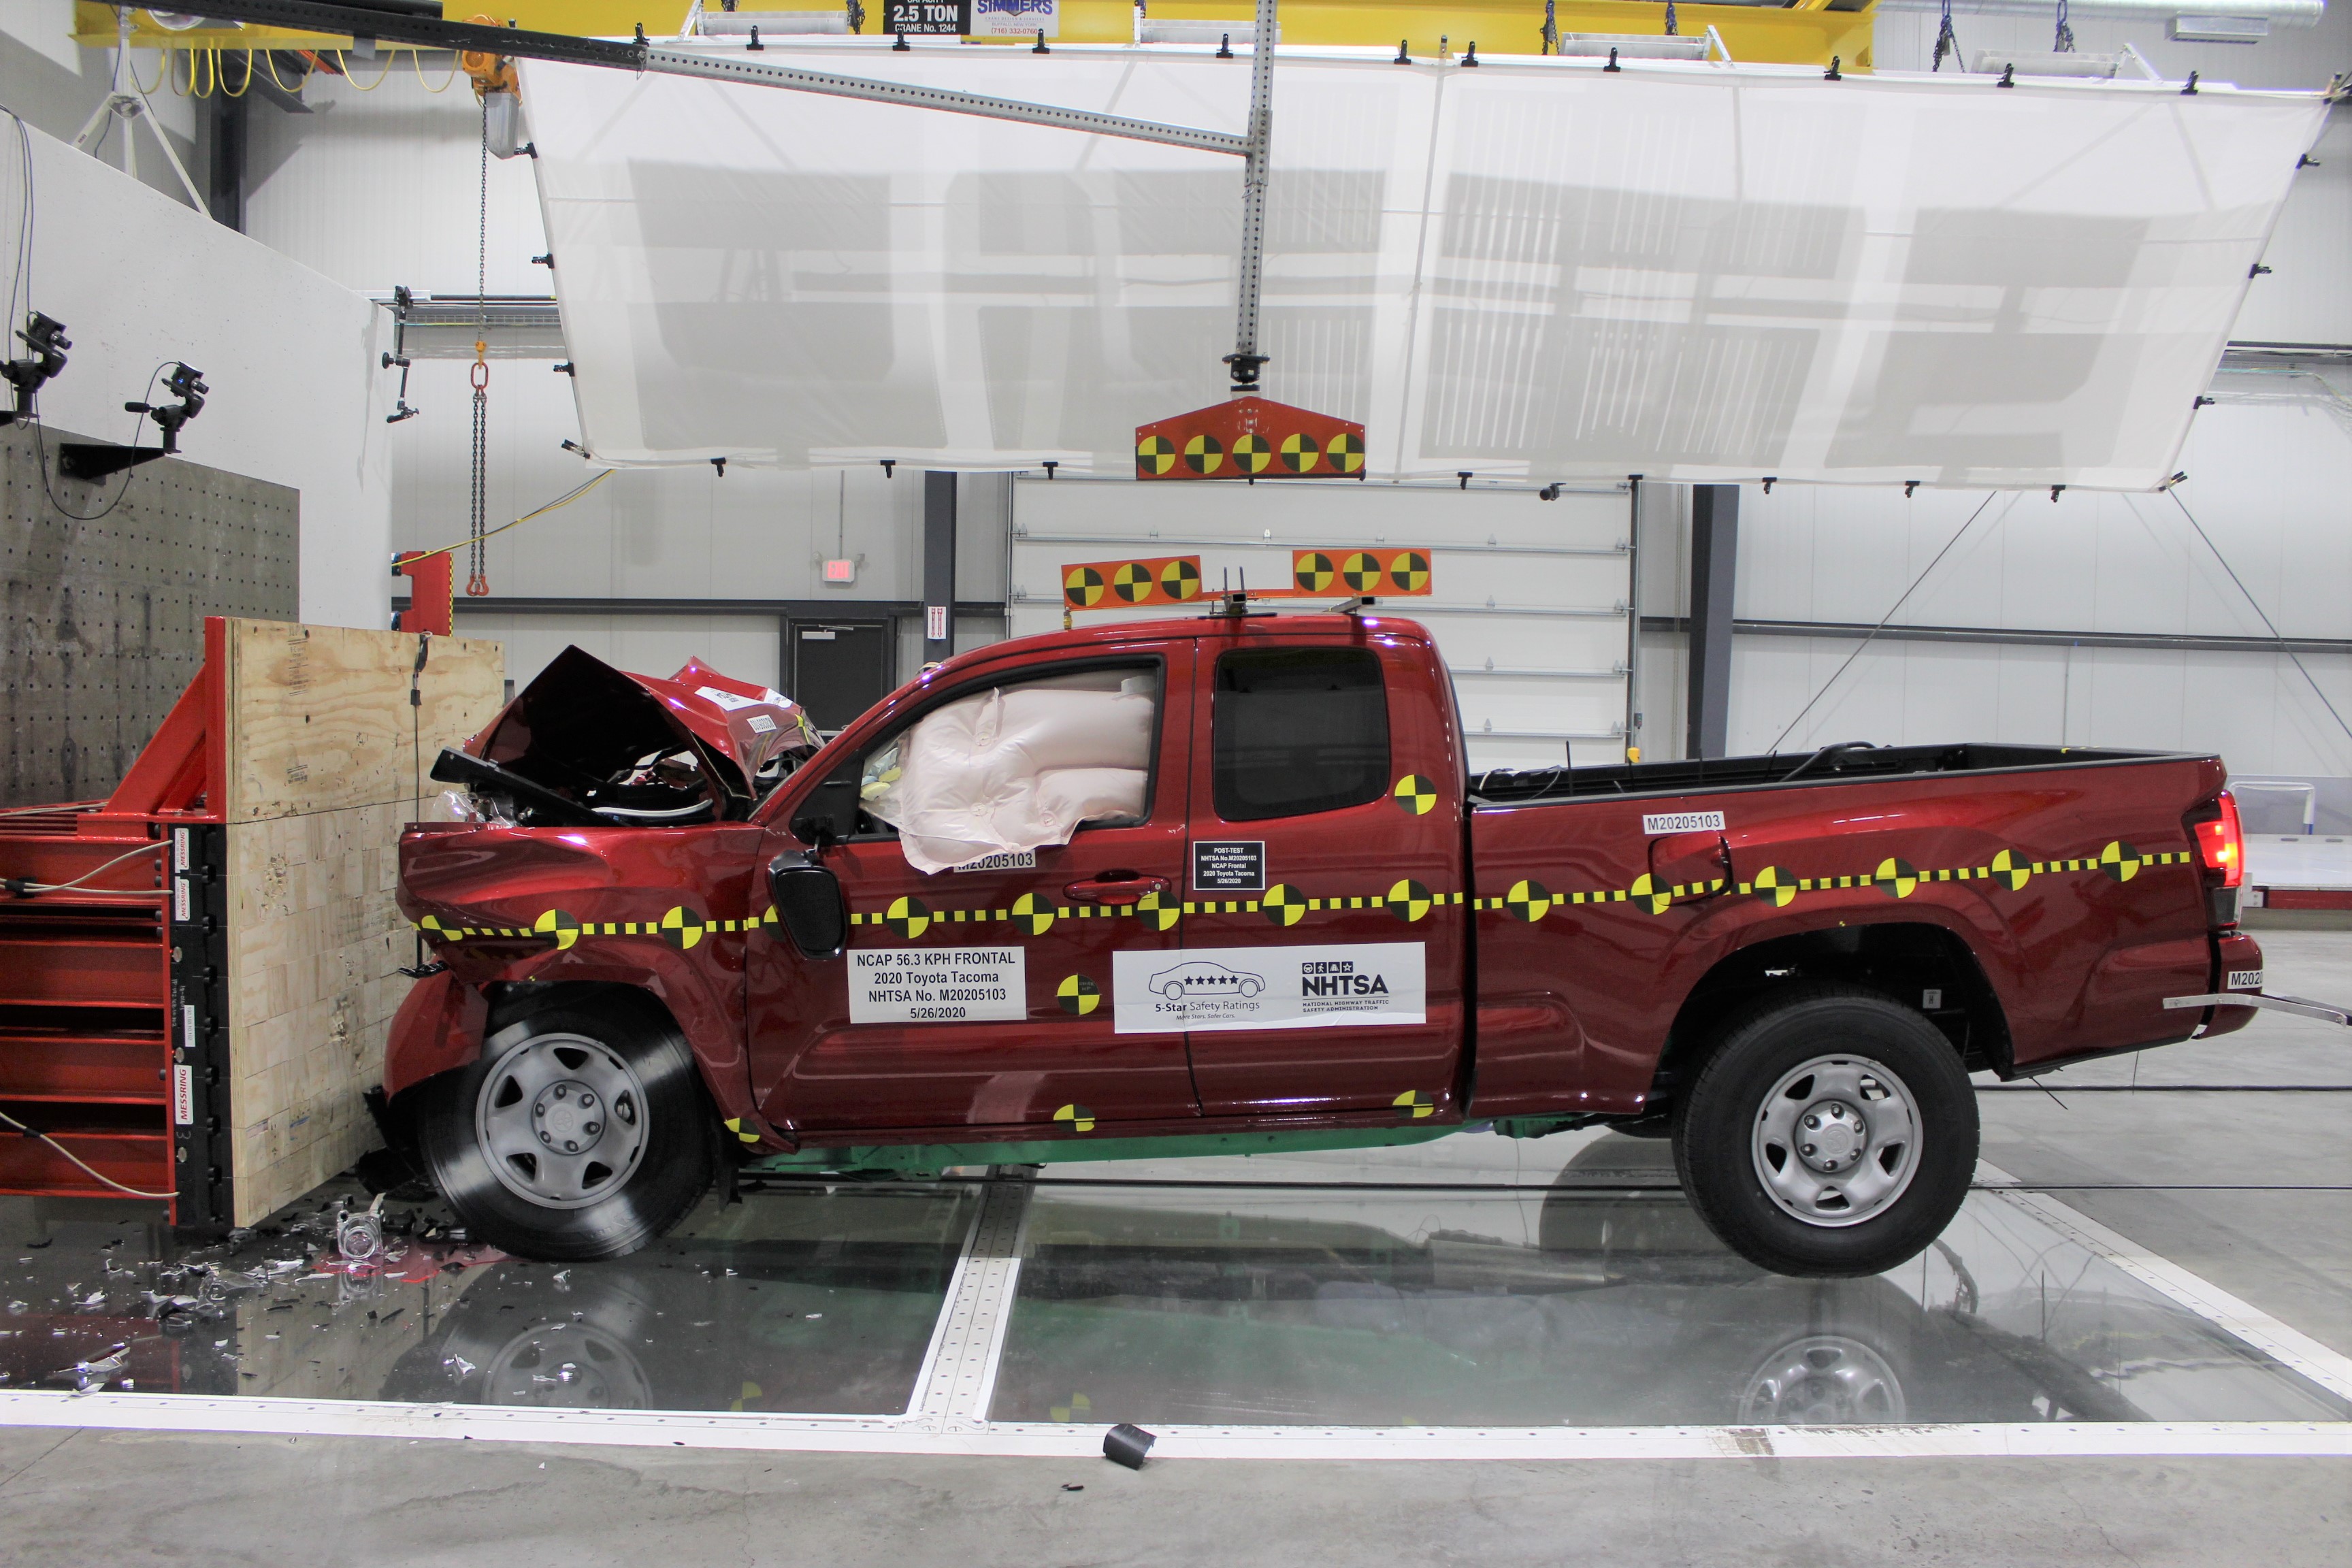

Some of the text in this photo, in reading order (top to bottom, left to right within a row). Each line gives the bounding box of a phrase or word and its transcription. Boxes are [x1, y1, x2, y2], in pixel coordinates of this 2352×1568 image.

[894, 5, 958, 22] 2.5 TON
[895, 24, 956, 32] CRANE No. 1244
[828, 561, 850, 578] EXIT
[1648, 815, 1720, 830] M20205103
[857, 952, 1015, 966] NCAP 56.3 KPH FRONTAL
[875, 971, 999, 987] 2020 Toyota Tacoma
[1303, 974, 1389, 996] NHTSA
[868, 989, 1006, 1002] NHTSA No. M20205103
[910, 1007, 966, 1019] 5/26/2020
[1156, 1000, 1260, 1013] 5-Star Safety Ratings
[179, 1069, 187, 1120] MESSRING
